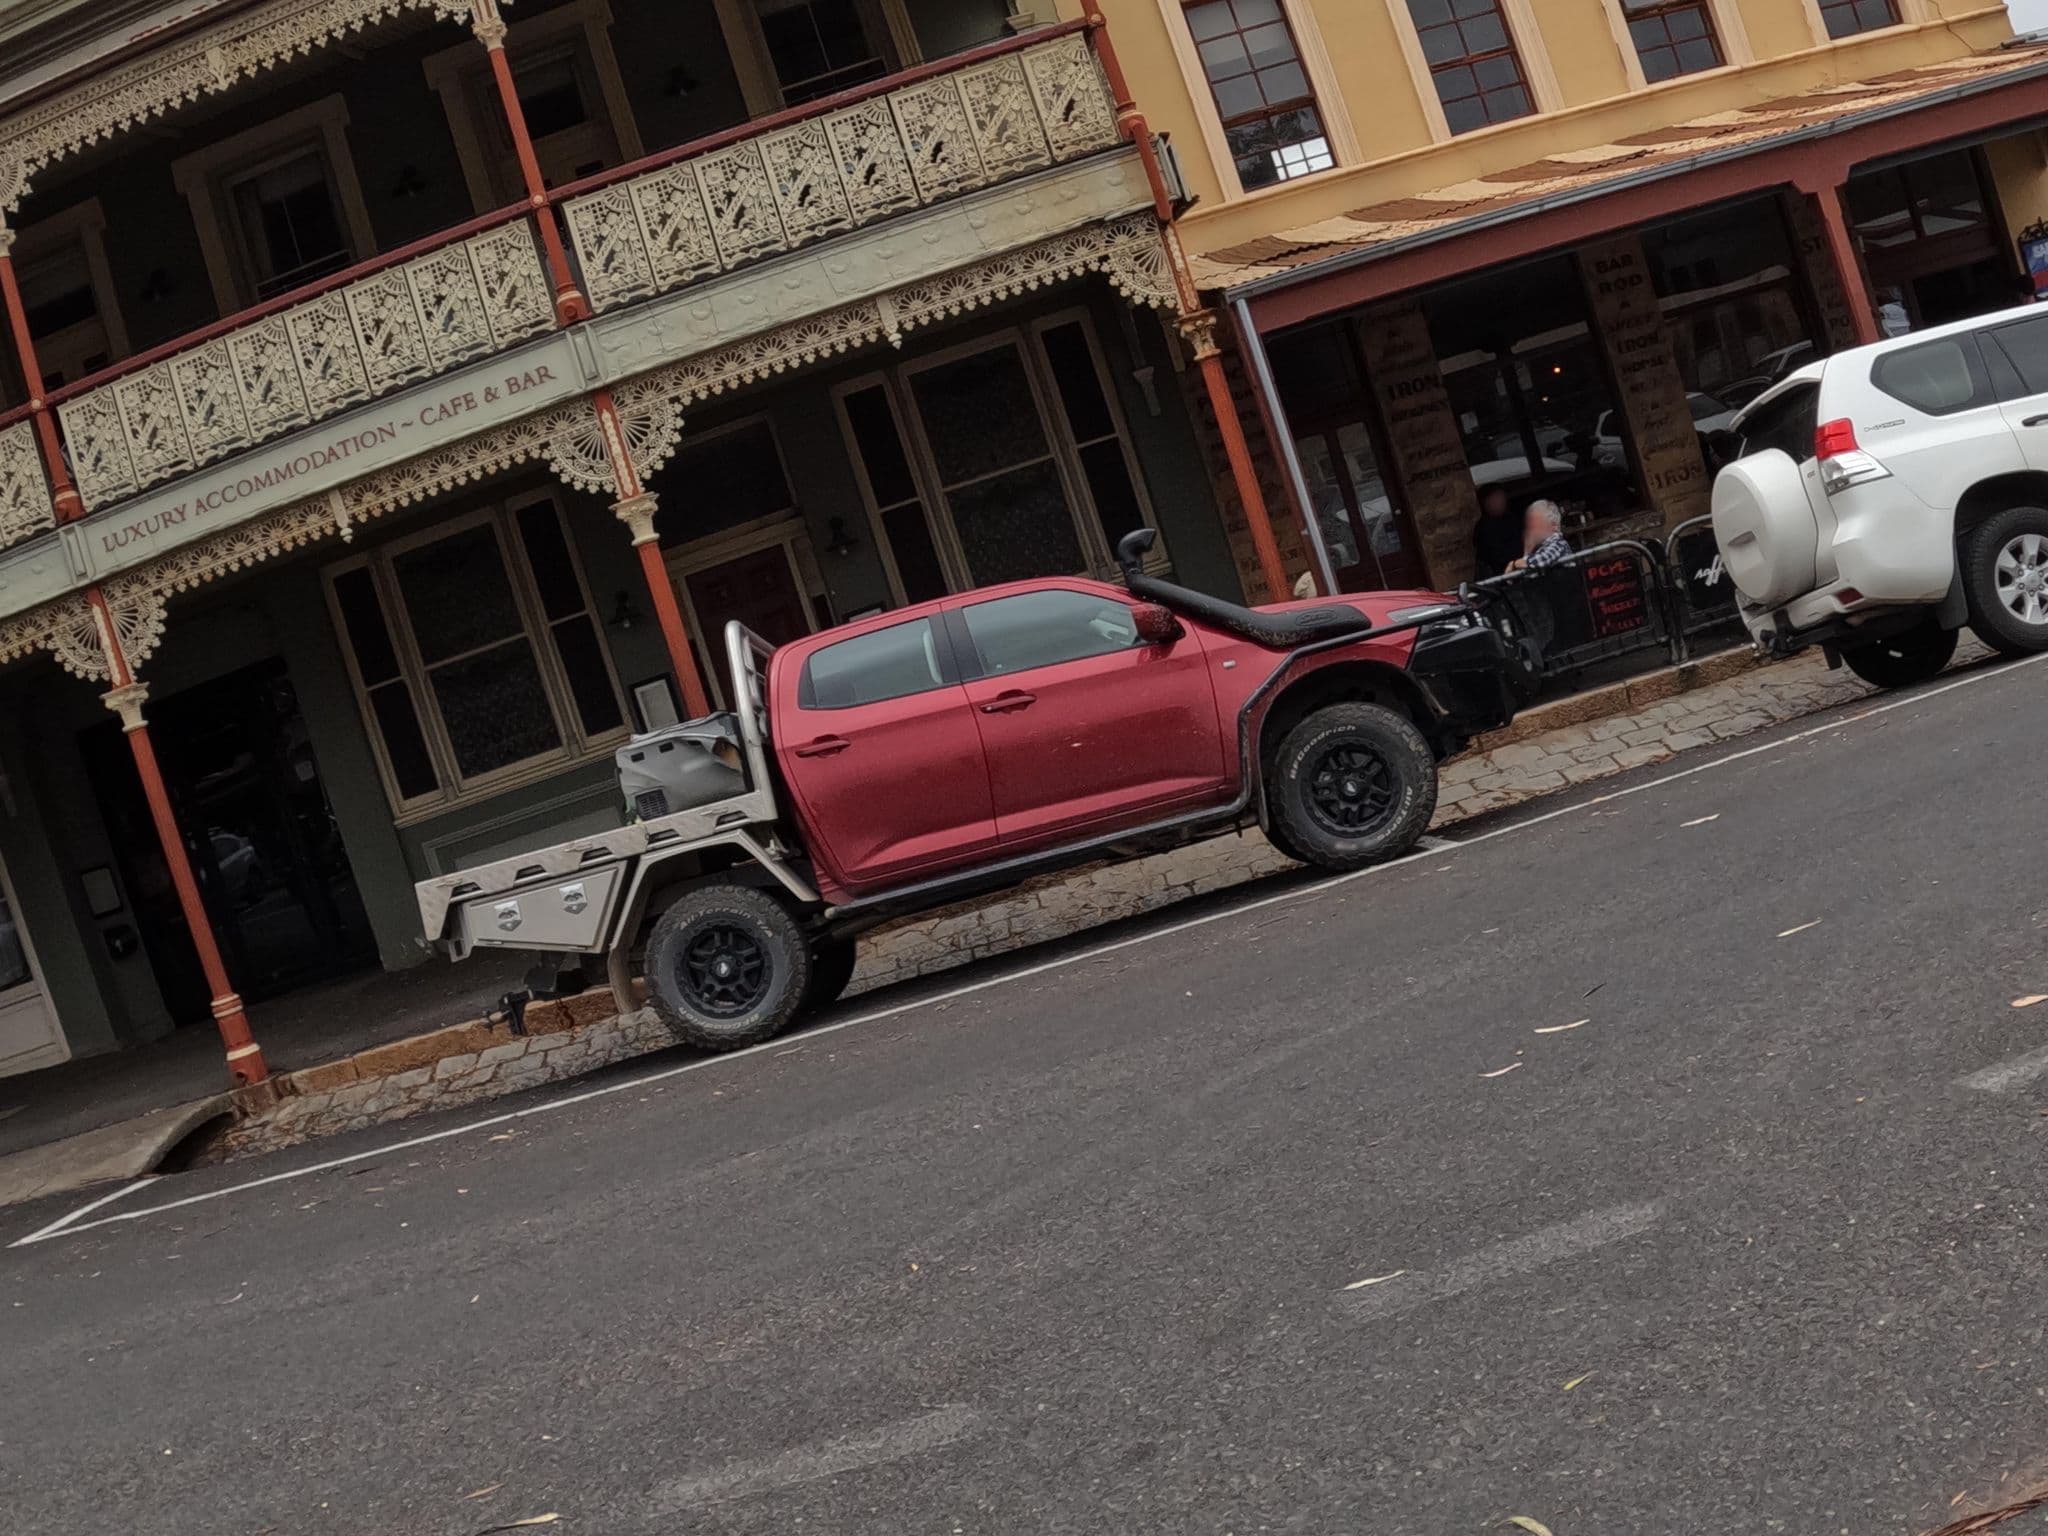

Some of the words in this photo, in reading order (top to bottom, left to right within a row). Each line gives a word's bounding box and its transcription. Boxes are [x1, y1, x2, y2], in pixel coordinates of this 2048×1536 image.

[101, 502, 190, 553] LUXURY
[194, 421, 399, 512] ACCOMMODATION
[418, 391, 478, 427] CAFE
[484, 386, 499, 402] &
[504, 364, 556, 396] BAR
